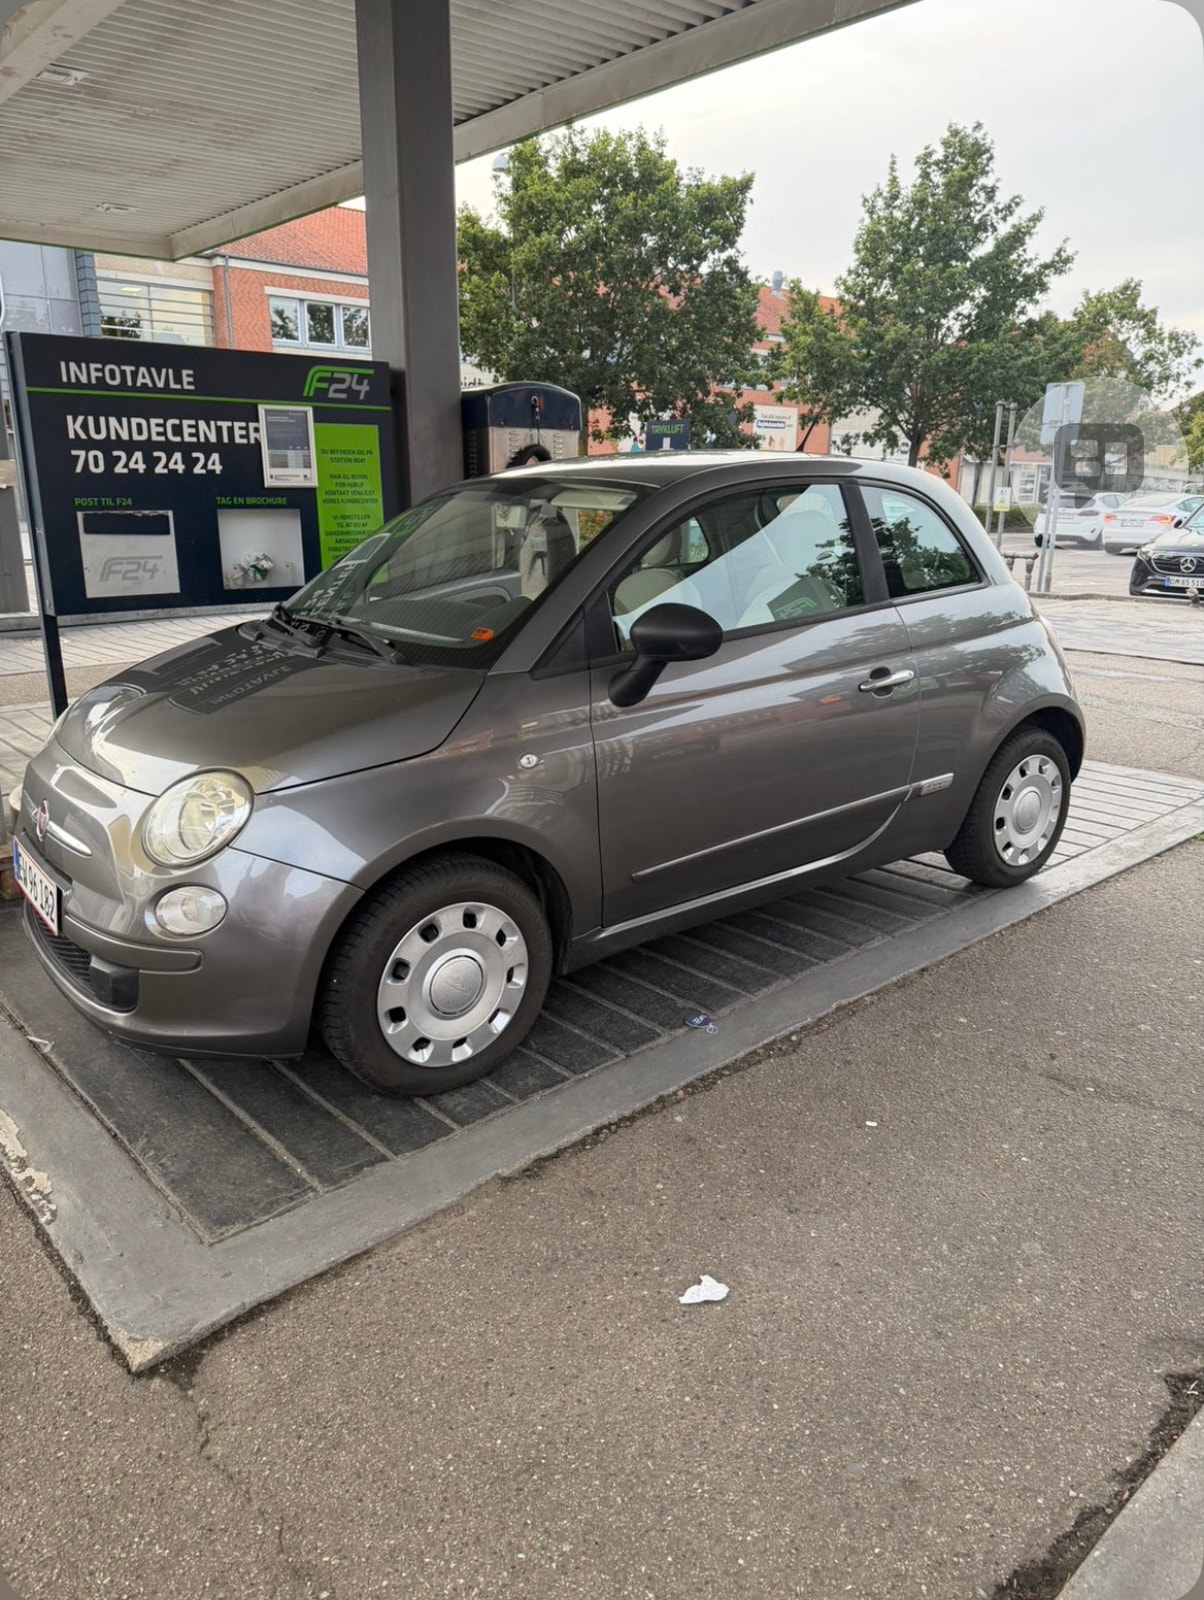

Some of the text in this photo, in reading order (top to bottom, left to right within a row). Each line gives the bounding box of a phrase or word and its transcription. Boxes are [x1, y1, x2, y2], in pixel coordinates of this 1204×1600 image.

[60, 361, 196, 390] INFOTAVLE
[303, 365, 374, 400] F24
[66, 415, 261, 444] KUNDECENTER
[650, 424, 685, 434] TRYKLUFT
[71, 450, 223, 475] 70 24 24 24
[74, 497, 133, 507] POST TIL F24
[216, 496, 287, 505] TAG EN BROCHURE
[99, 555, 163, 581] F24
